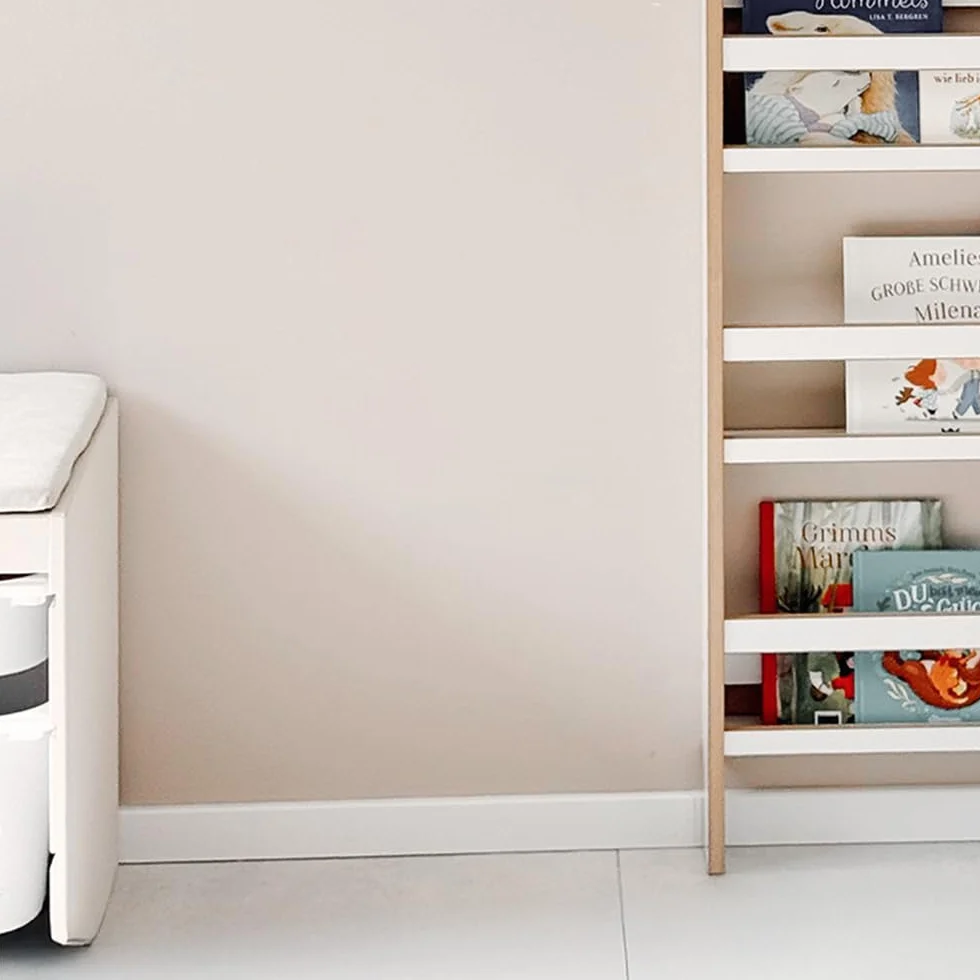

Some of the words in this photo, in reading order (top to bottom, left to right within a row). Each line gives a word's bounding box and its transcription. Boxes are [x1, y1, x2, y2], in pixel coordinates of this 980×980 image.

[933, 73, 952, 83] wie
[955, 73, 974, 83] lieb
[802, 521, 897, 543] Grimms
